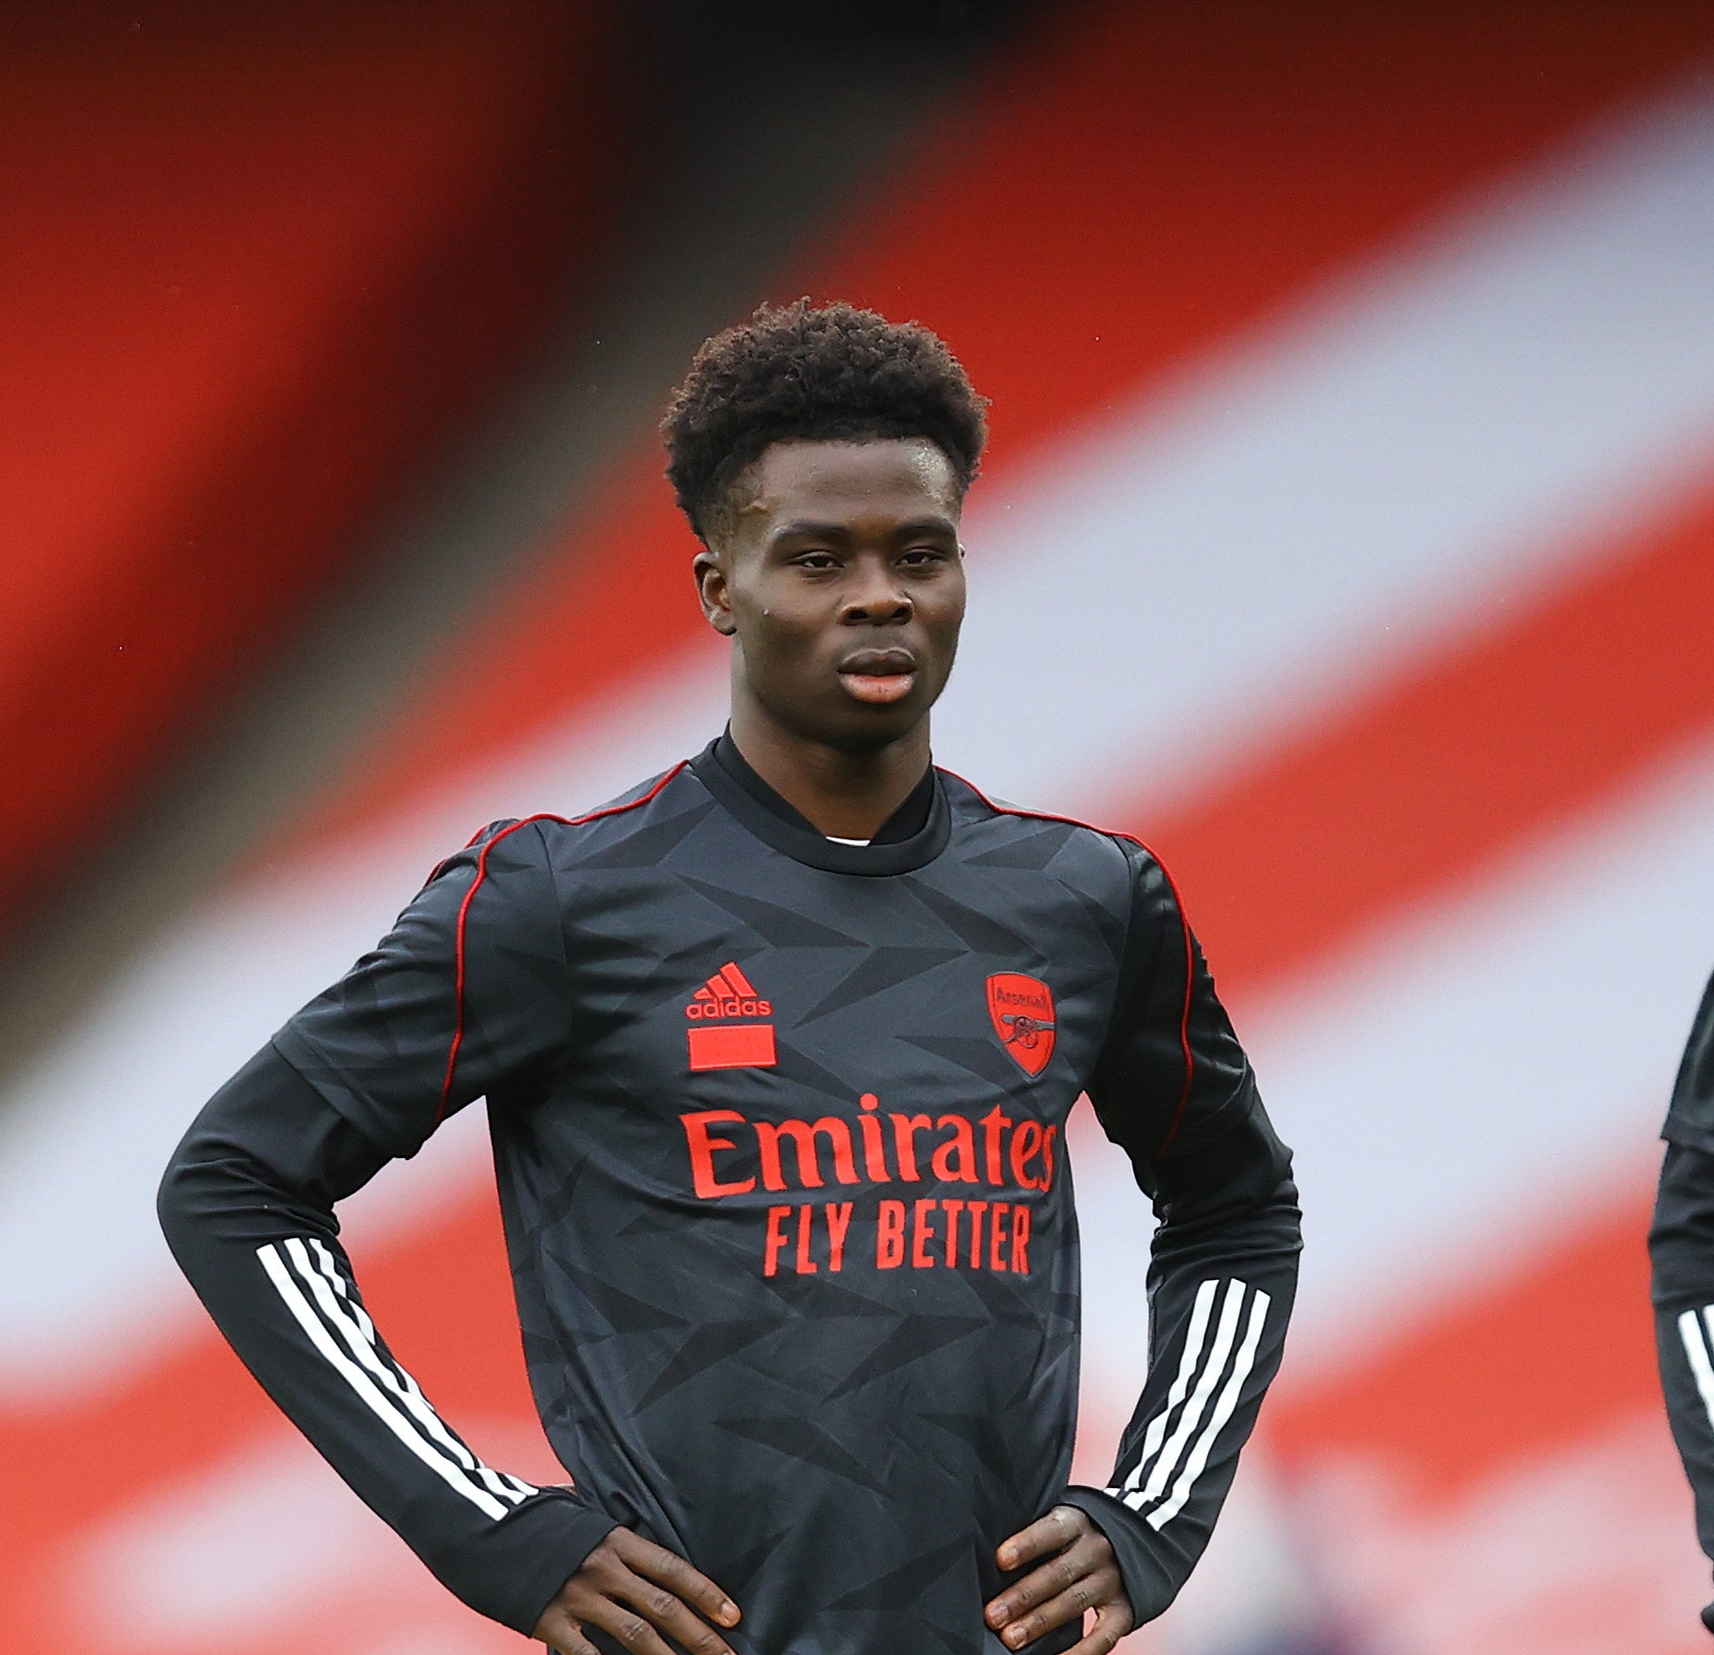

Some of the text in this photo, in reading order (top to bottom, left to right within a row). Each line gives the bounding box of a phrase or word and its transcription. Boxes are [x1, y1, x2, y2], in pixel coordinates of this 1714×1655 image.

[686, 998, 773, 1020] adidas
[679, 1093, 1057, 1199] Emirates
[764, 1199, 1031, 1277] FLY BETTER
